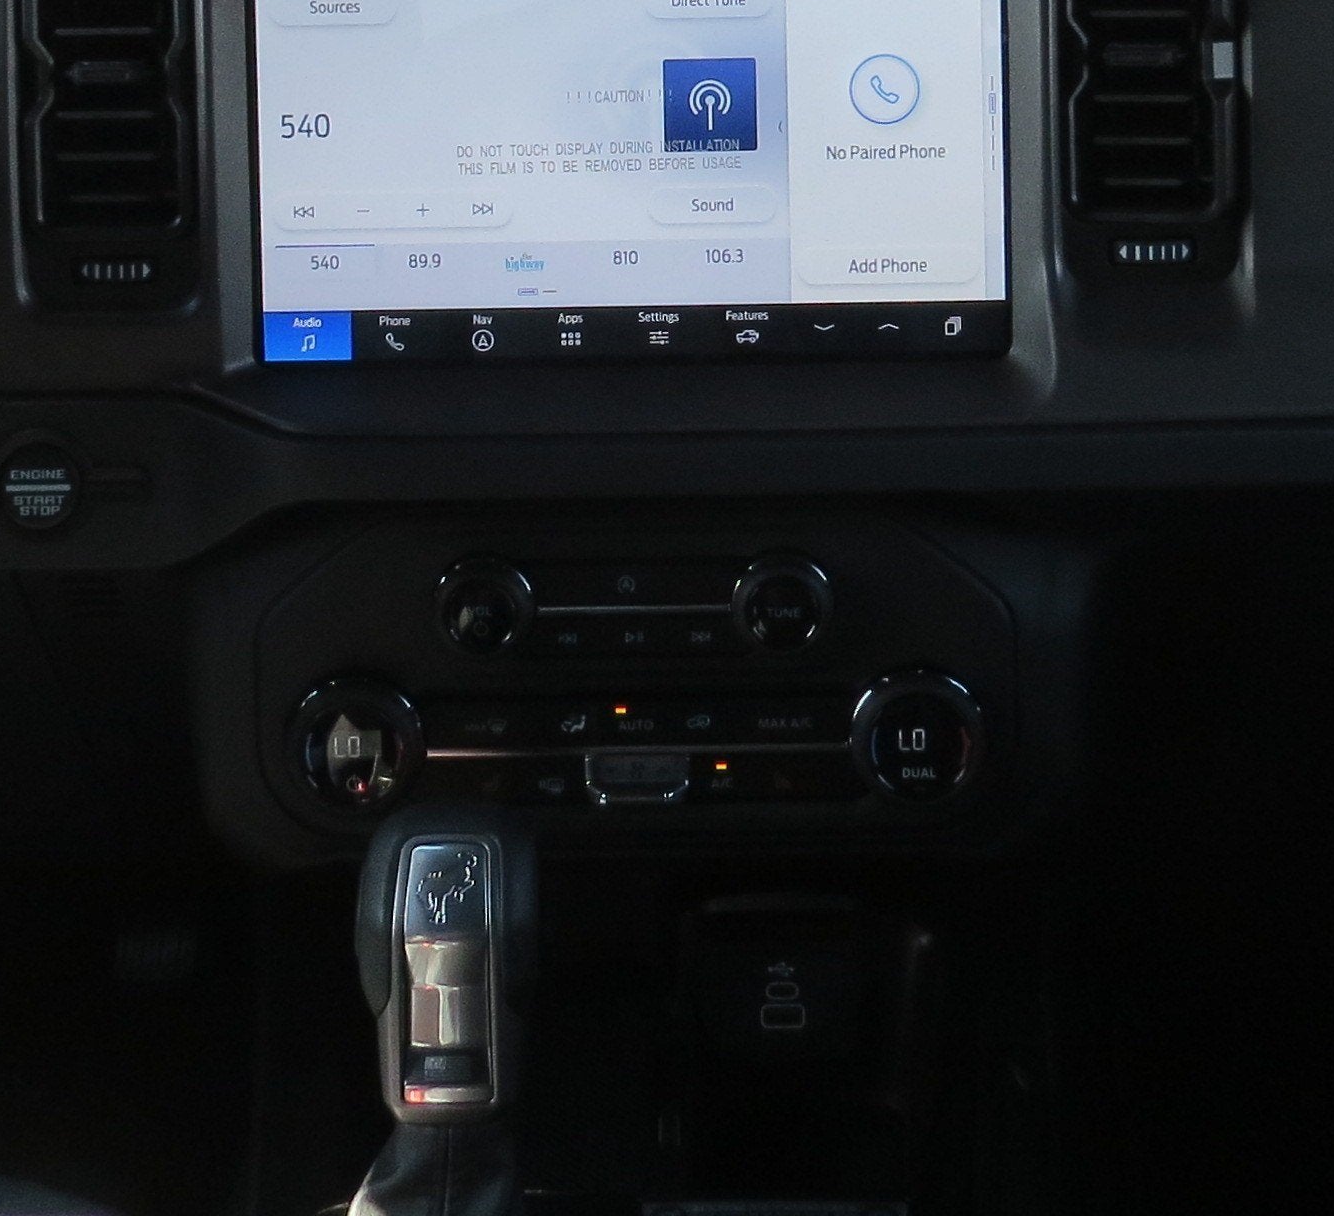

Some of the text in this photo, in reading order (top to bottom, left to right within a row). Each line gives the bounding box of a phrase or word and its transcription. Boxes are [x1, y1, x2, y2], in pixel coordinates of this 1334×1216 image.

[309, 0, 361, 16] Sources
[280, 113, 331, 139] 540
[456, 138, 740, 159] DO NOT TOUCH DISPLAY DURING INSTALLATION
[826, 143, 946, 161] No Paired Phone
[458, 155, 742, 176] THIS FILM IS TO BE REMOVED BEFORE USAGE
[691, 197, 734, 214] Sound
[310, 254, 340, 271] 540
[408, 253, 442, 270] 89.9
[504, 256, 546, 273] highway
[612, 249, 639, 266] 810
[705, 248, 745, 265] 106.3
[848, 258, 928, 275] Add Phone
[292, 316, 323, 329] Audio
[378, 314, 411, 327] Phone
[472, 313, 494, 326] Nav
[557, 313, 584, 327] Apps
[637, 310, 681, 325] Settings
[725, 309, 770, 322] Features
[9, 468, 67, 481] ENGINE
[13, 494, 65, 506] START
[18, 505, 61, 517] STOP
[766, 607, 802, 619] TUNE
[618, 719, 654, 731] AUTO
[758, 717, 787, 730] MAX
[334, 734, 361, 759] LO
[897, 728, 927, 753] LO
[901, 766, 937, 780] DUAL
